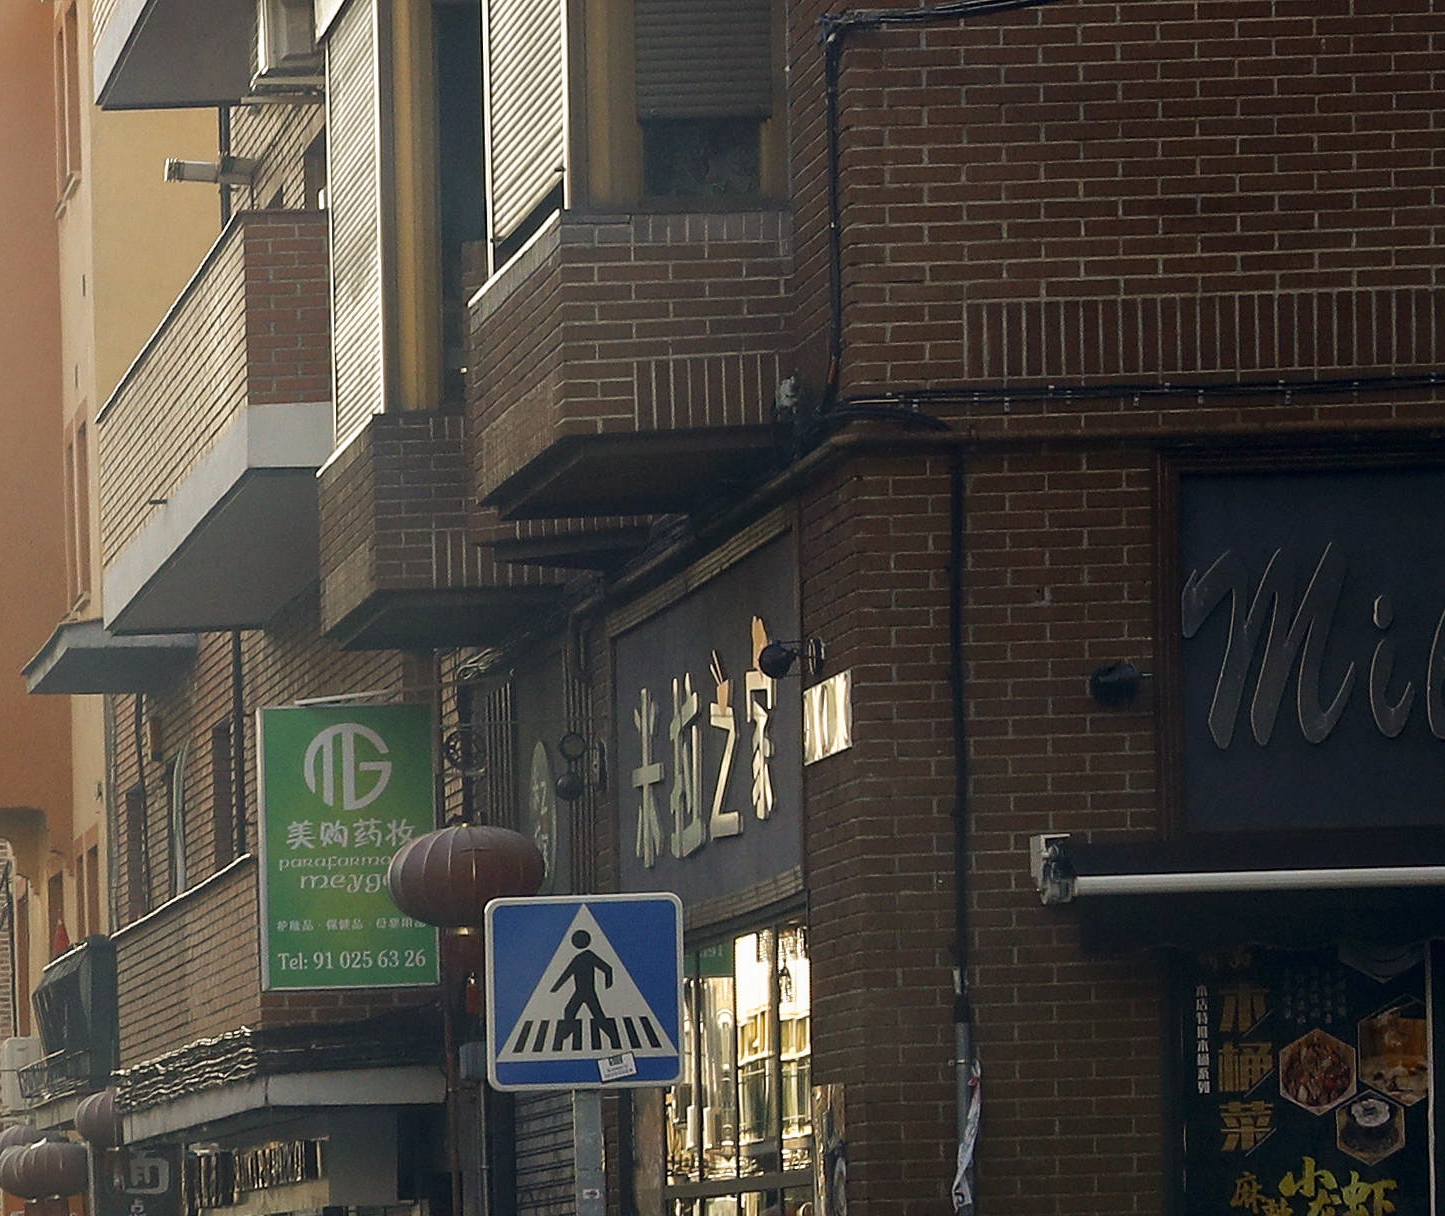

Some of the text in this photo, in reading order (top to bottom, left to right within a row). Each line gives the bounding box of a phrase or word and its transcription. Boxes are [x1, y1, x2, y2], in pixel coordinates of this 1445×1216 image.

[285, 818, 416, 850] 美购药妆
[277, 949, 426, 970] Tel: 91 025 63 26
